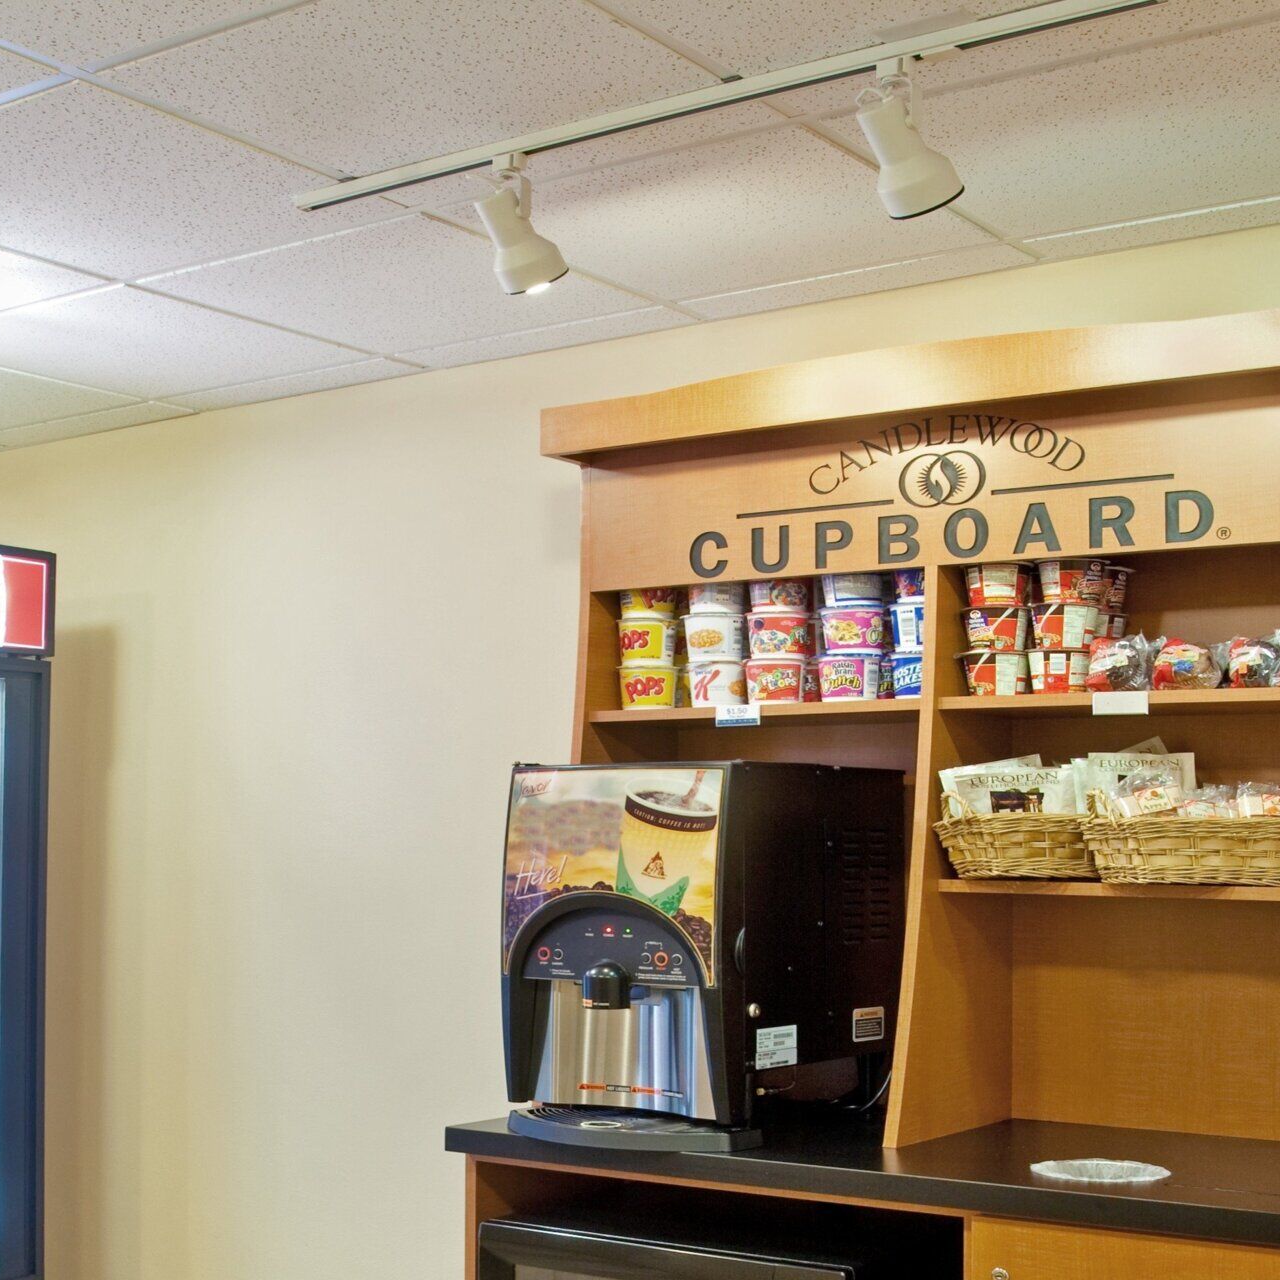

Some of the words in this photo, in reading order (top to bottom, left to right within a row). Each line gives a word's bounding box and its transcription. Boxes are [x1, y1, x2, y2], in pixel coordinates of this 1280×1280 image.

[809, 415, 1086, 496] CANDLEWOOD
[689, 490, 1215, 579] CUPBOARD
[624, 677, 666, 703] POPS
[694, 669, 720, 701] K
[1099, 758, 1180, 768] EUROPEAN
[970, 772, 1058, 786] EUROPEAN
[658, 819, 683, 829] COFFEE
[514, 854, 568, 896] Here!
